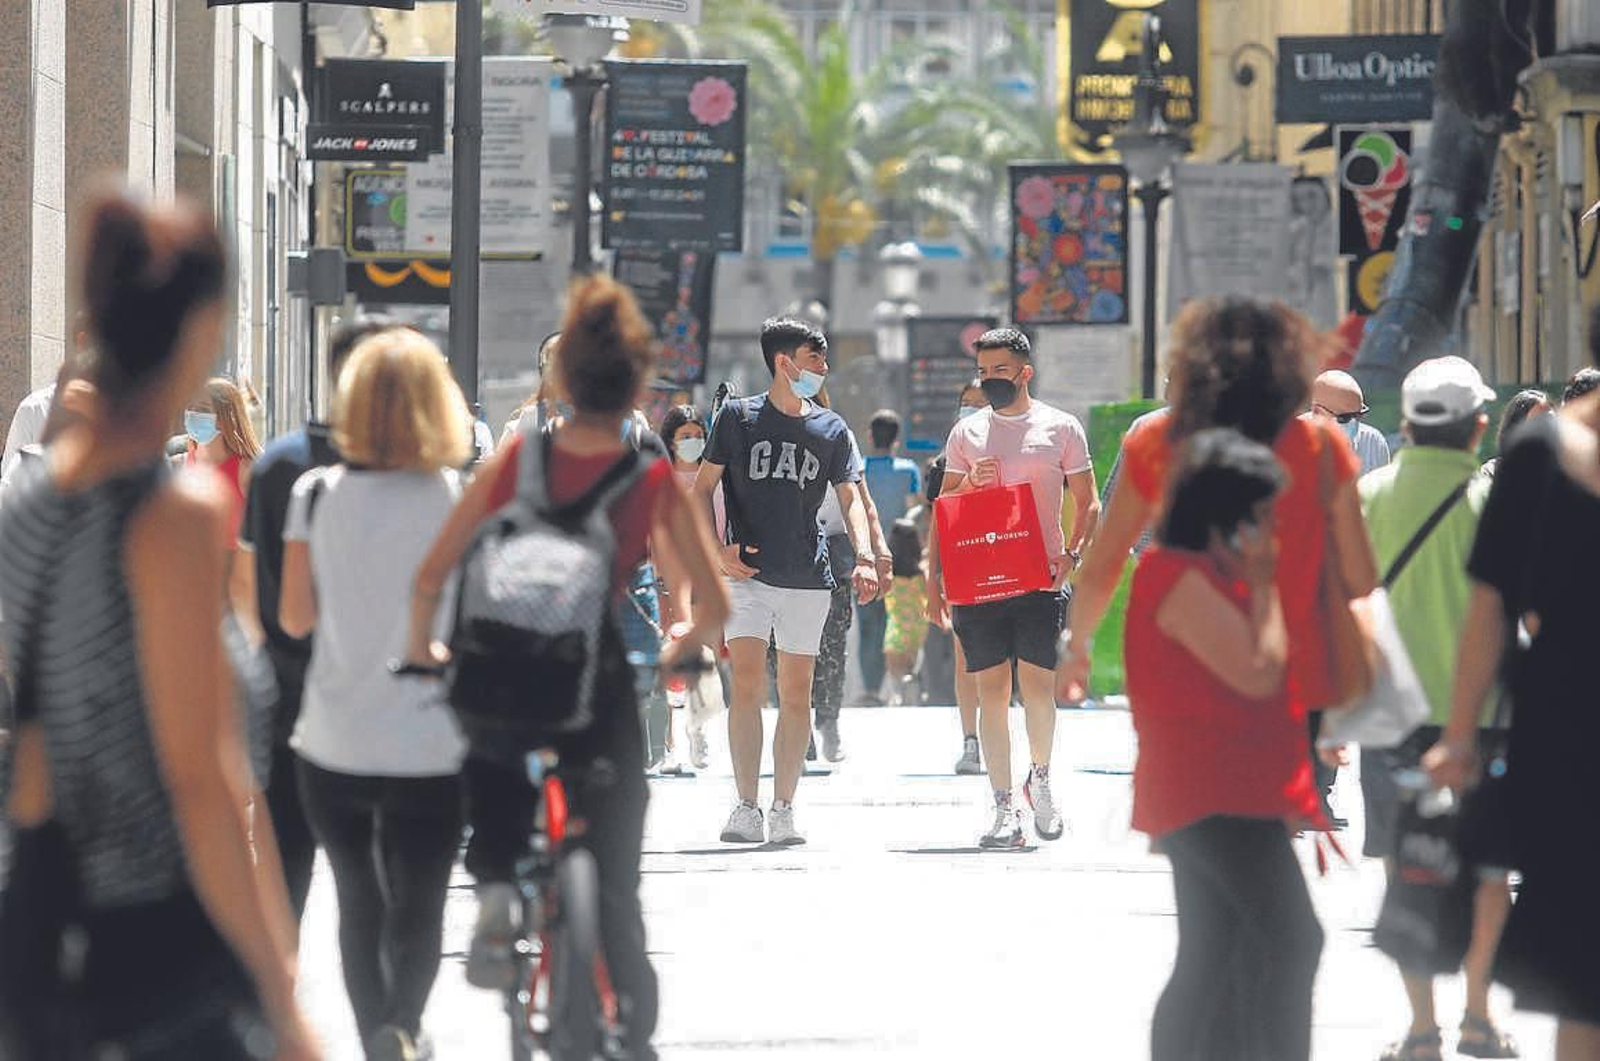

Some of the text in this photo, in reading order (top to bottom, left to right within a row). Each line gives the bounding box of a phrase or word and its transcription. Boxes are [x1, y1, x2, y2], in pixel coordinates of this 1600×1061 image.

[1293, 51, 1437, 87] Ulloa Optic
[340, 100, 431, 114] SCALPERS
[312, 137, 355, 150] JACK
[367, 138, 418, 151] JONES
[634, 146, 656, 160] LA
[610, 163, 632, 177] DE
[748, 440, 820, 490] GAP
[996, 530, 1030, 540] MORENO
